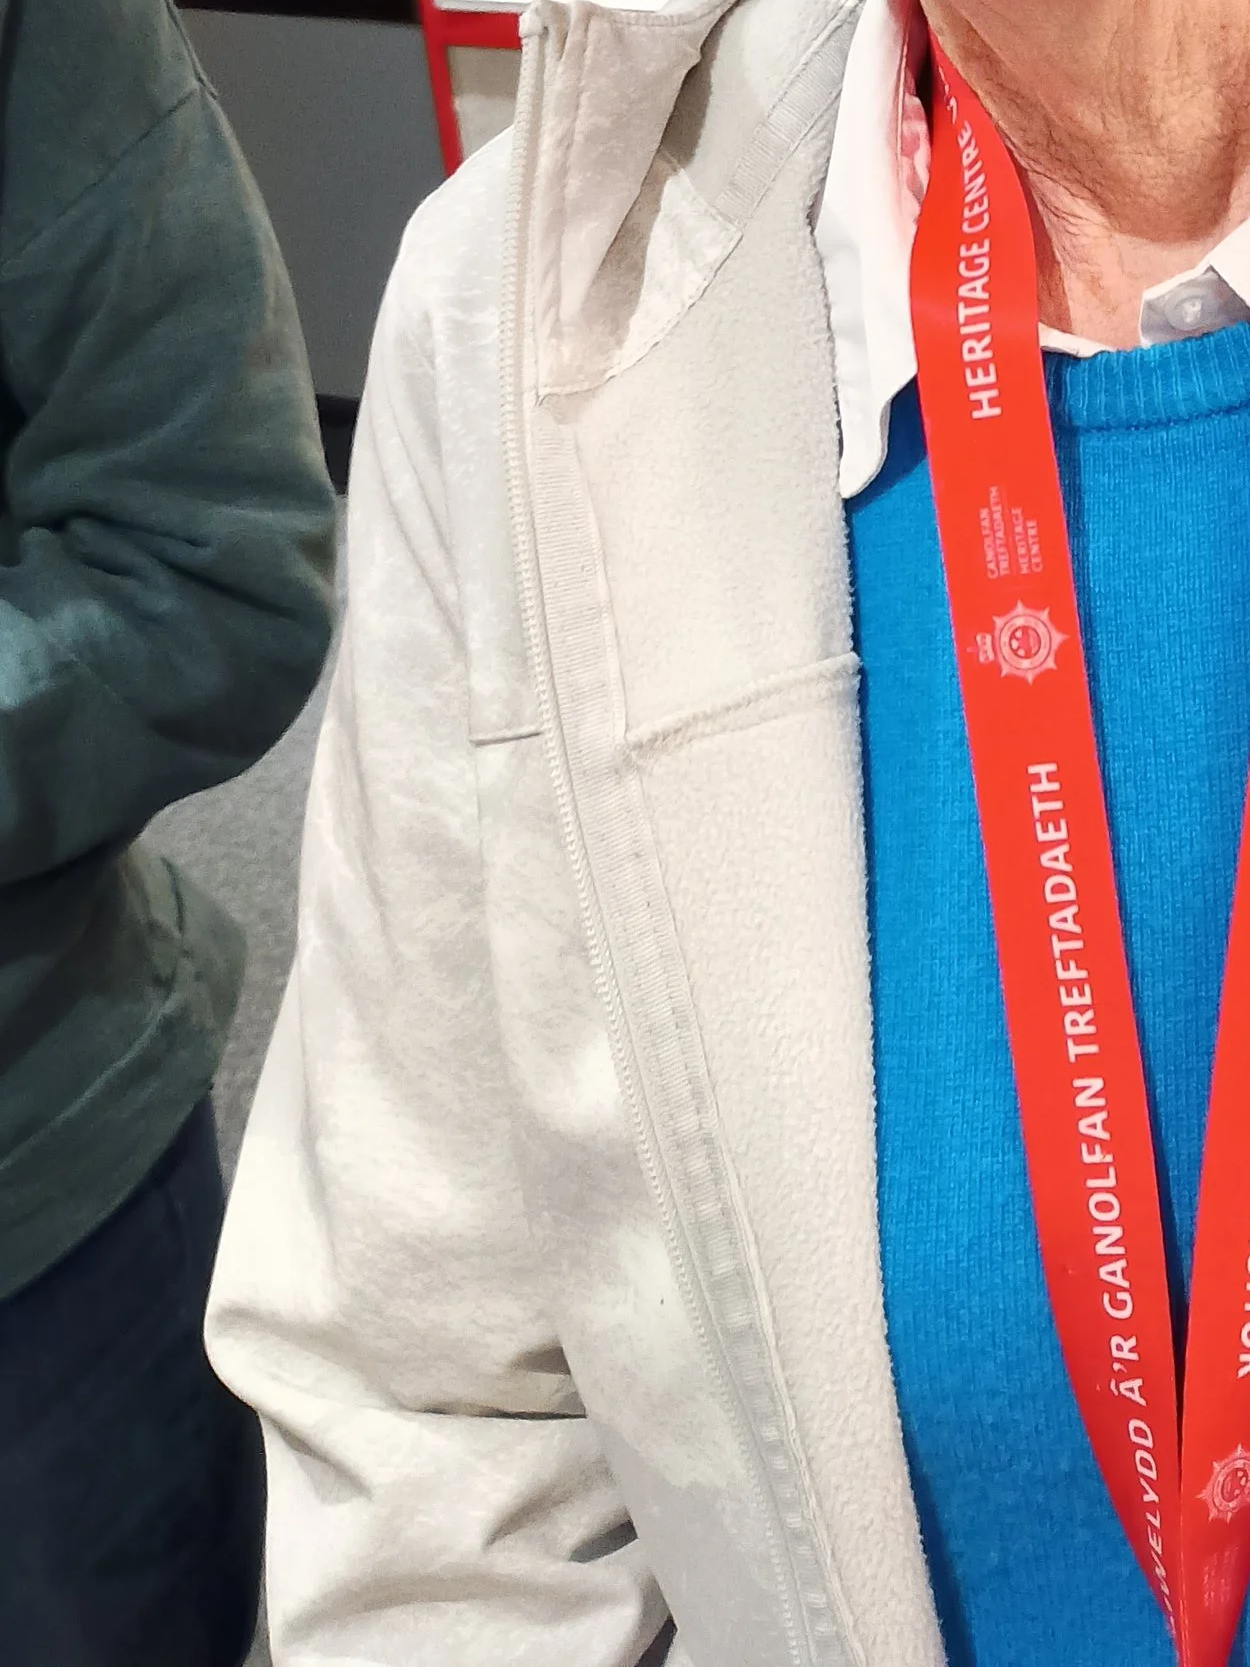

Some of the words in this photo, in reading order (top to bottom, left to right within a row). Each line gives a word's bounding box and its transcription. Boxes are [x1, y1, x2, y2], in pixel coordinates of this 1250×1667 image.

[957, 119, 991, 235] CENTRE
[957, 237, 1003, 420] HERITAGE
[1011, 506, 1030, 575] HERITAGE
[1026, 518, 1043, 573] CENTRE
[1026, 762, 1100, 1064] TREFTADAETH
[1072, 1076, 1134, 1320] GANOLFAN
